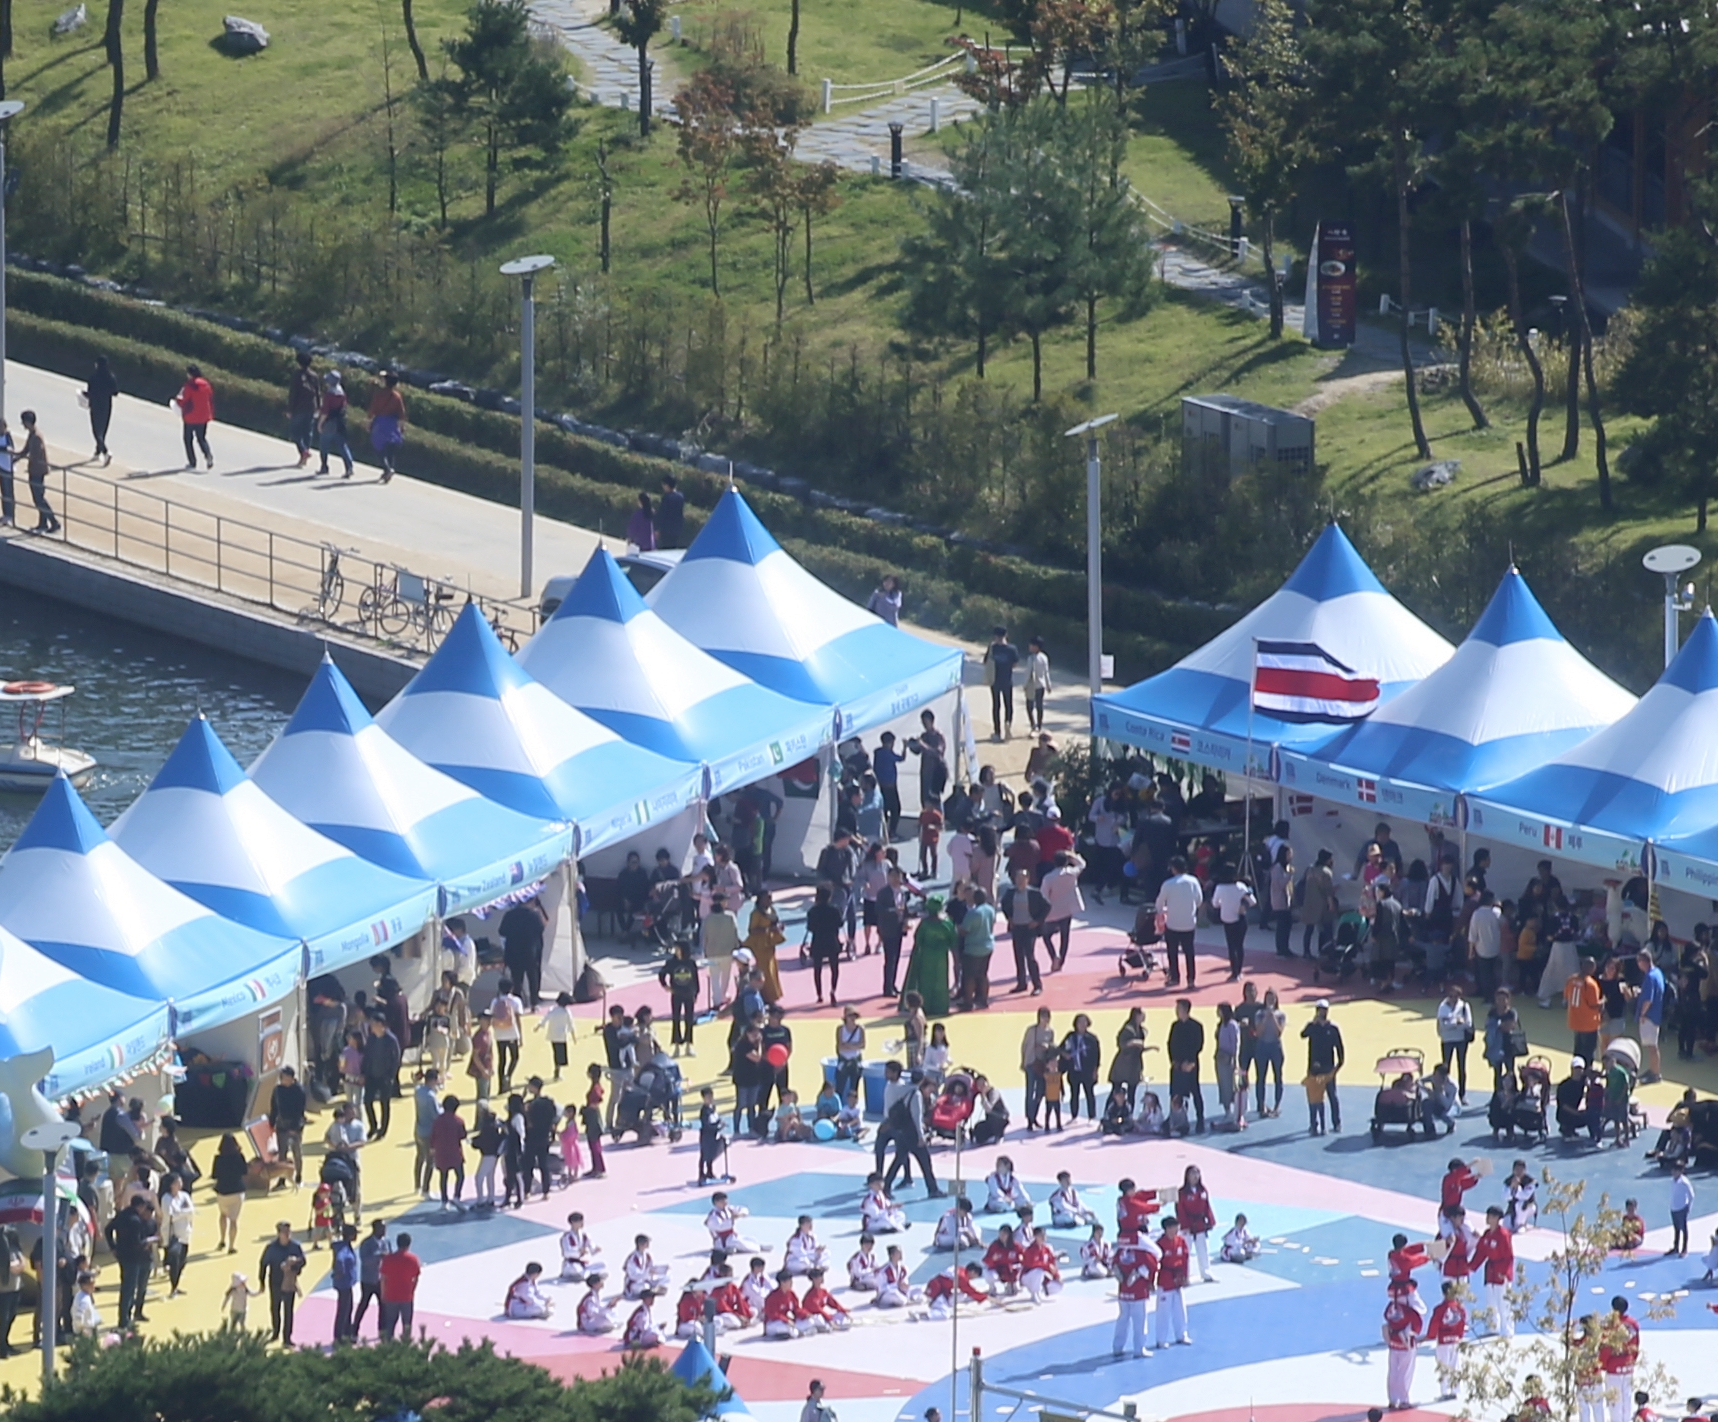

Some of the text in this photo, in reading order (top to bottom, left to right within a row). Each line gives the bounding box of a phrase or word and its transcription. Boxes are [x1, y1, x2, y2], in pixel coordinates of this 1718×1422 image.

[1125, 720, 1148, 738] Costa
[1149, 726, 1165, 743] Rica
[1197, 739, 1231, 761] 코스타리카
[1316, 771, 1351, 791] Denmark
[1382, 787, 1403, 804] 덴마크
[1519, 820, 1538, 839] Peru
[1568, 834, 1583, 850] 페루
